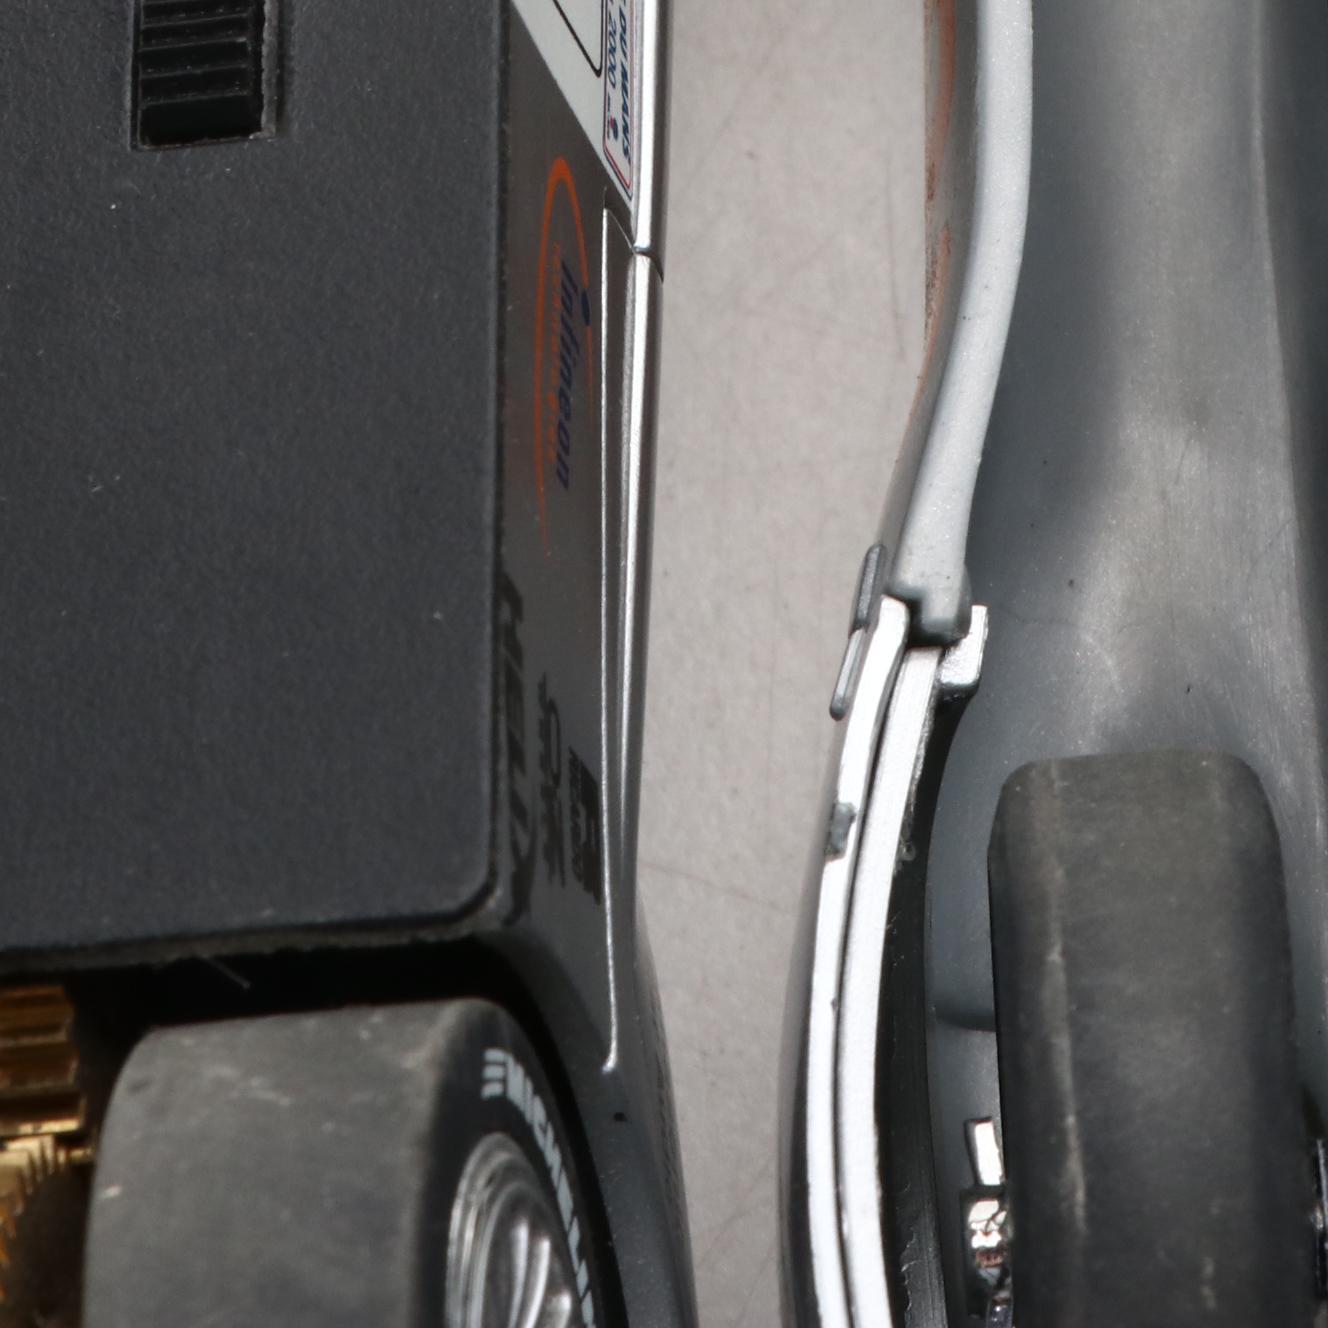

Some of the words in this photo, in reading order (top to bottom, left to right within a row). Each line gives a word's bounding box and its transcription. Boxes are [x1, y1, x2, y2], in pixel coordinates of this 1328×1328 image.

[607, 9, 618, 90] 2000
[618, 5, 629, 60] DU
[620, 61, 632, 165] MANS
